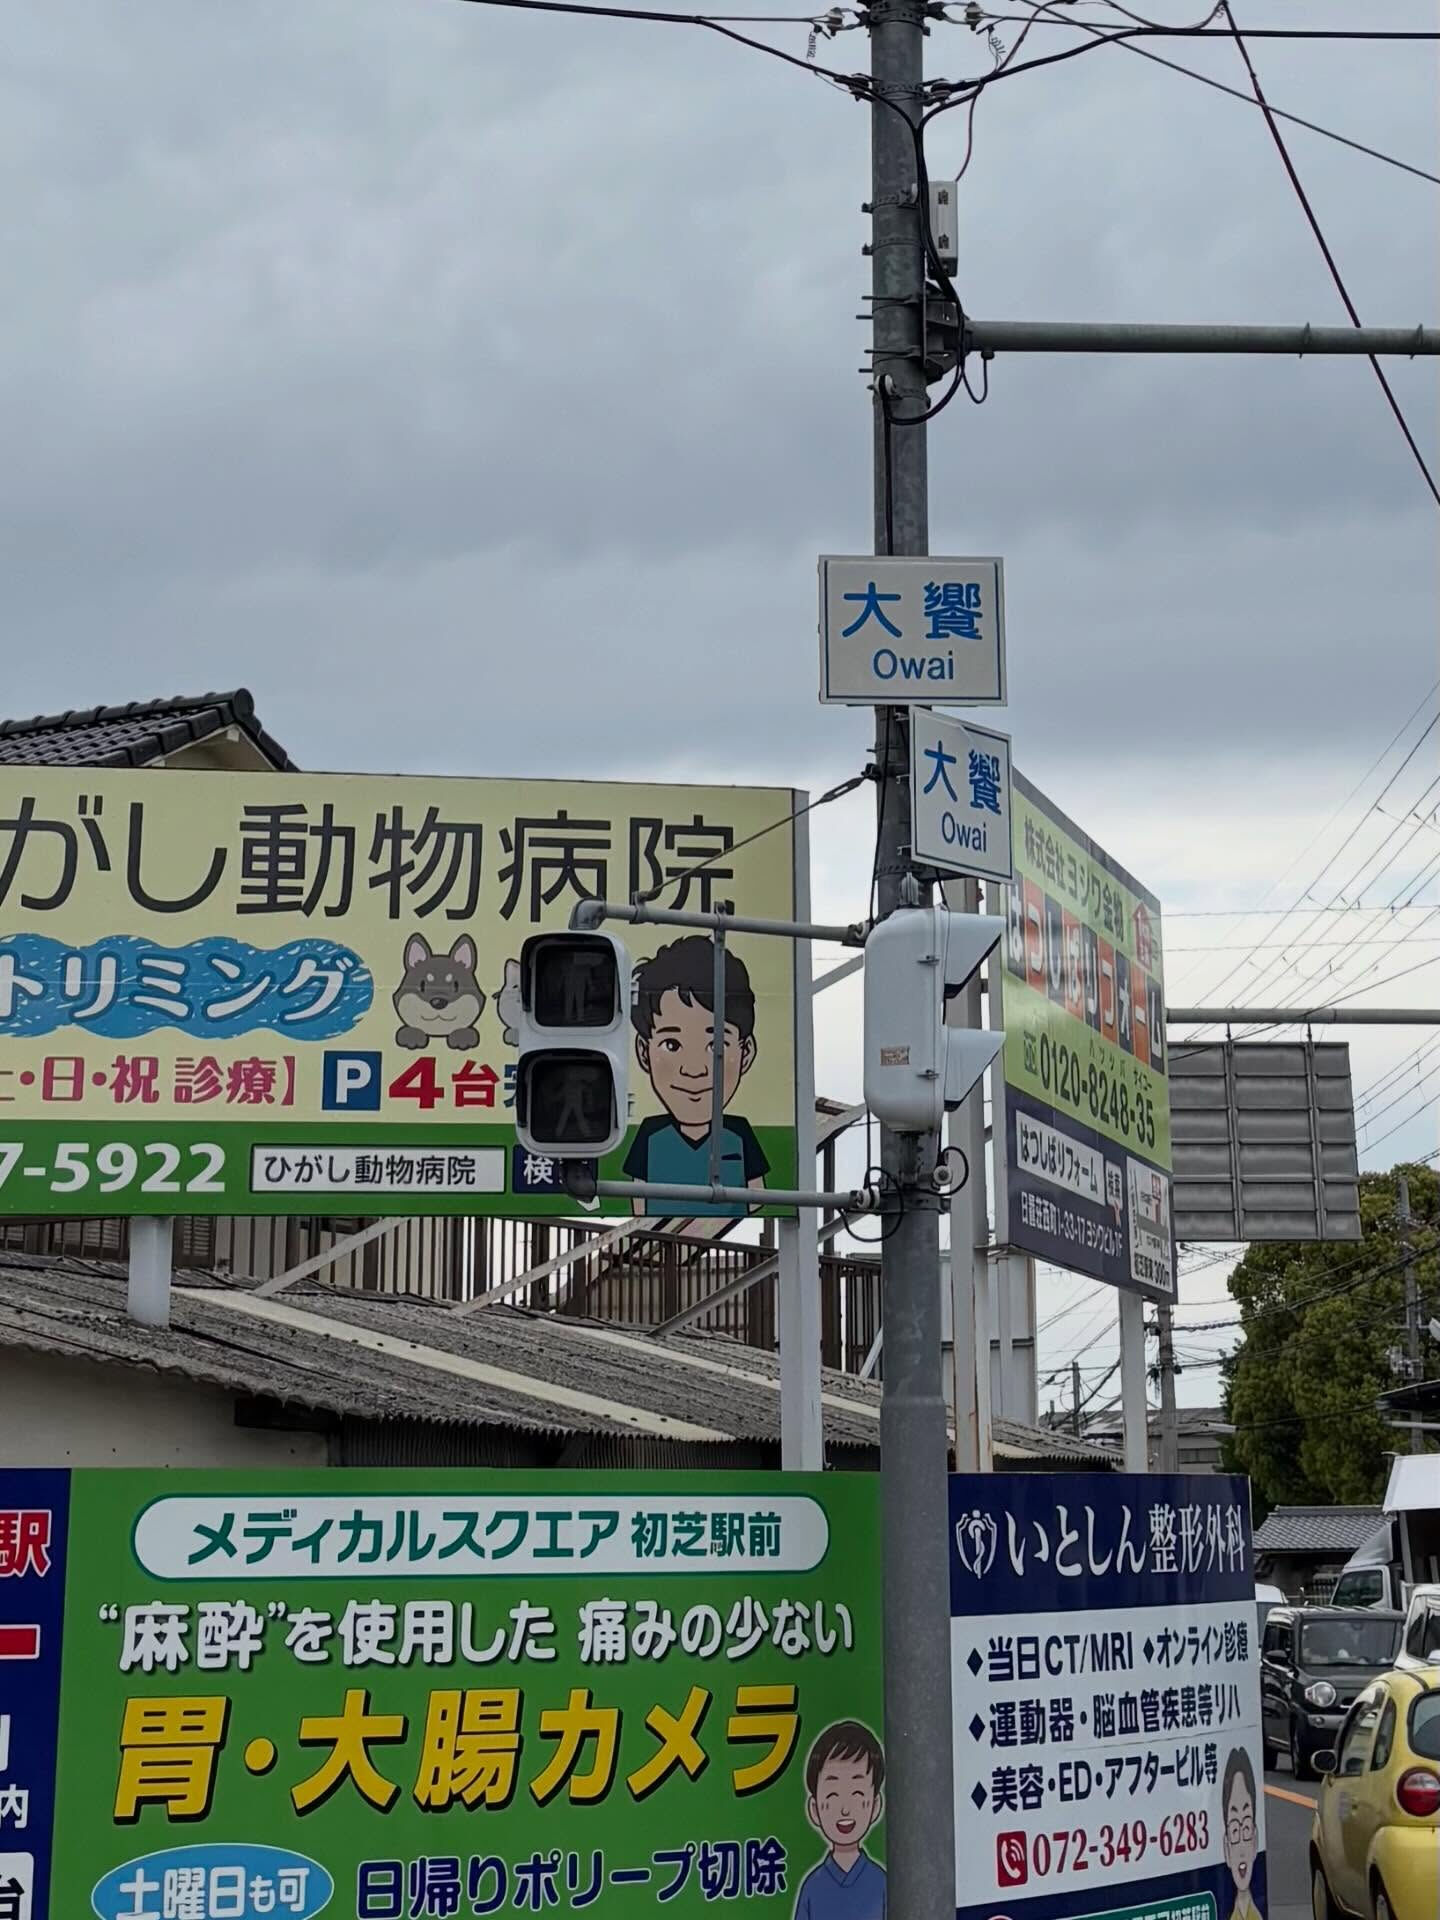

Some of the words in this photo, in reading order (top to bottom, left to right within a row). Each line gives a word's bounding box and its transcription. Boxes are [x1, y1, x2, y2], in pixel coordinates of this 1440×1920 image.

[842, 581, 983, 640] 大饗
[873, 648, 954, 680] Owai
[923, 740, 1002, 816] 大饗
[0, 794, 734, 923] がし動物病院
[941, 811, 987, 853] Owai
[0, 951, 354, 1023] トリミング
[336, 1062, 373, 1104] P
[1040, 1032, 1155, 1149] 0120-8248-35
[264, 1152, 477, 1186] ひがし動物病院
[523, 1154, 564, 1186] 検
[188, 1507, 620, 1566] メディカルスクエア
[631, 1511, 782, 1557] 初芝駅前
[1004, 1502, 1245, 1577] いとしん整形外科
[578, 1595, 854, 1663] 痛みの少ない
[987, 1631, 1134, 1682] 当日CT/MRI
[1156, 1621, 1249, 1669] オンライン診療
[989, 1683, 1241, 1749] 運動器・脳血管疾患等リハ
[114, 1684, 801, 1822] 胃・大腸カメラ
[1033, 1809, 1211, 1877] 072-349-6283
[117, 1862, 310, 1920] 土曜日も可
[356, 1838, 787, 1920] 日帰りポリープ切除
